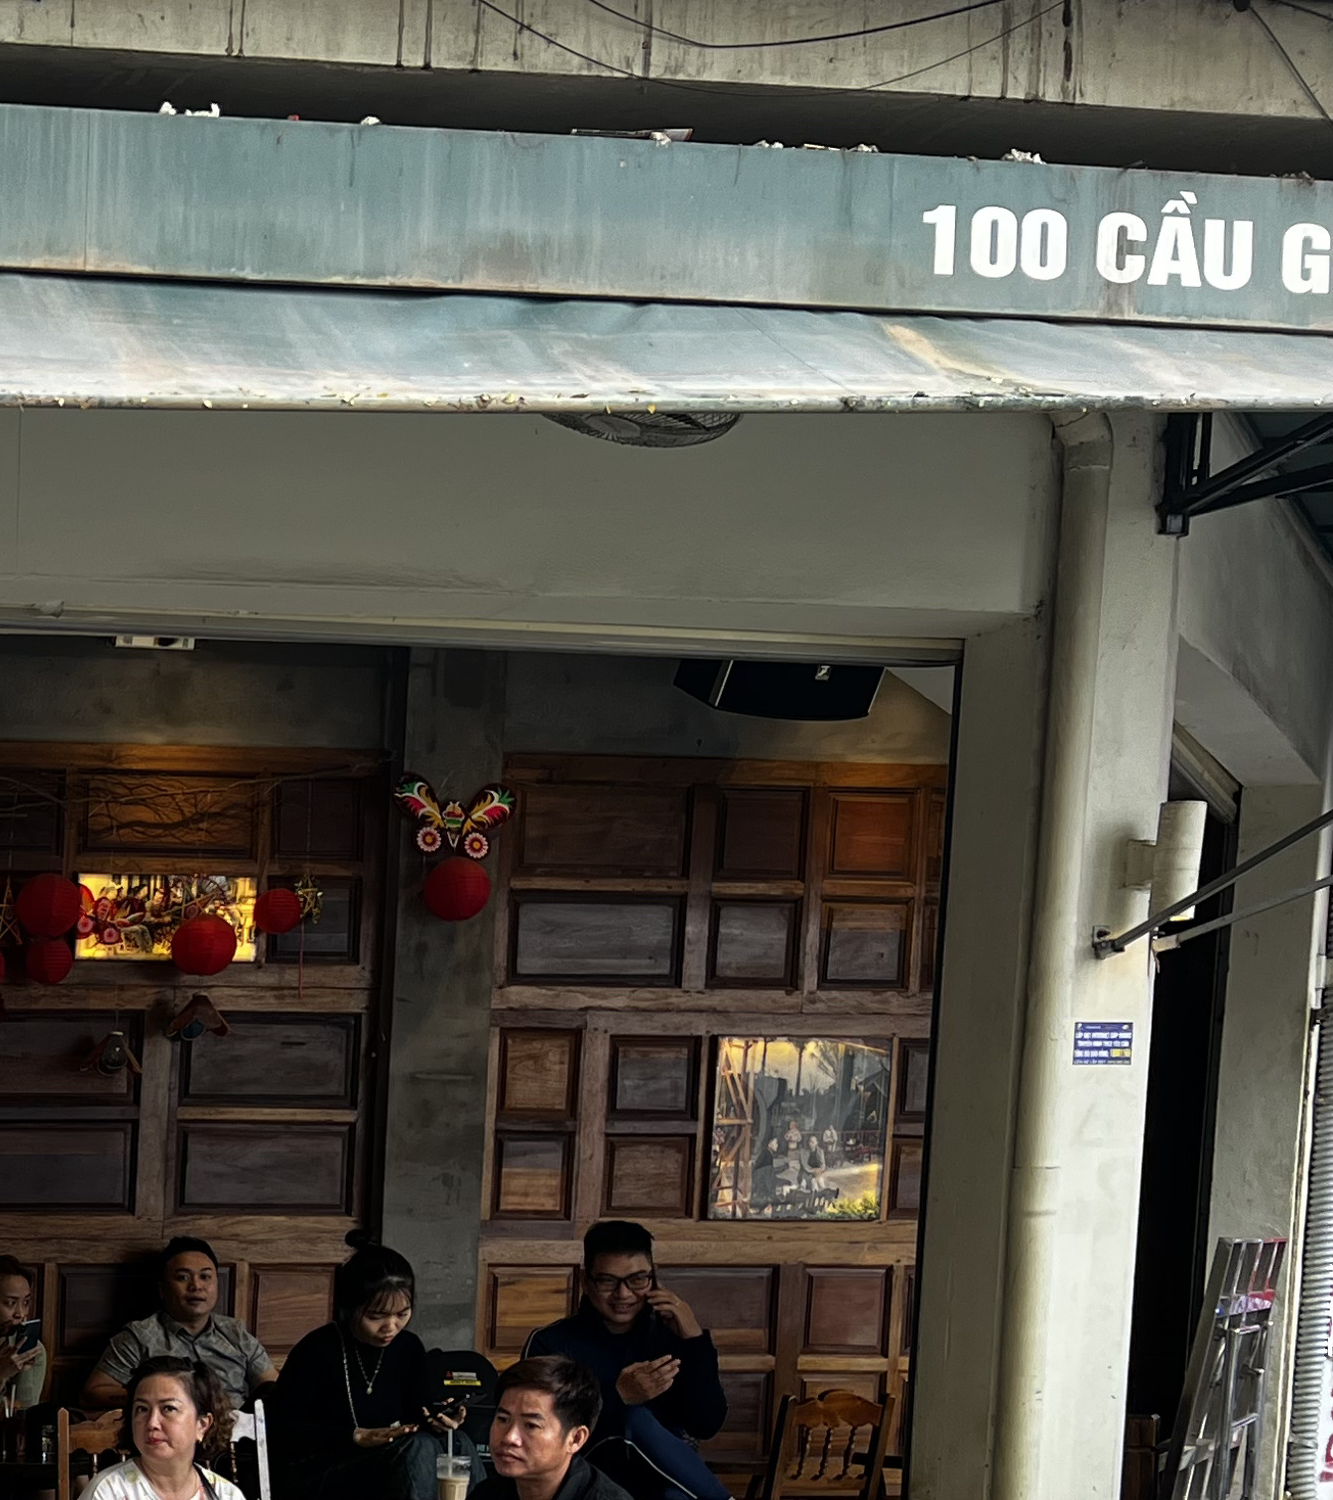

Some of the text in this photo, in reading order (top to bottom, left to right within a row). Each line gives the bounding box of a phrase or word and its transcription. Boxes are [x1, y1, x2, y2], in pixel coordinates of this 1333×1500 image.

[922, 190, 1332, 295] 100 CẦU G
